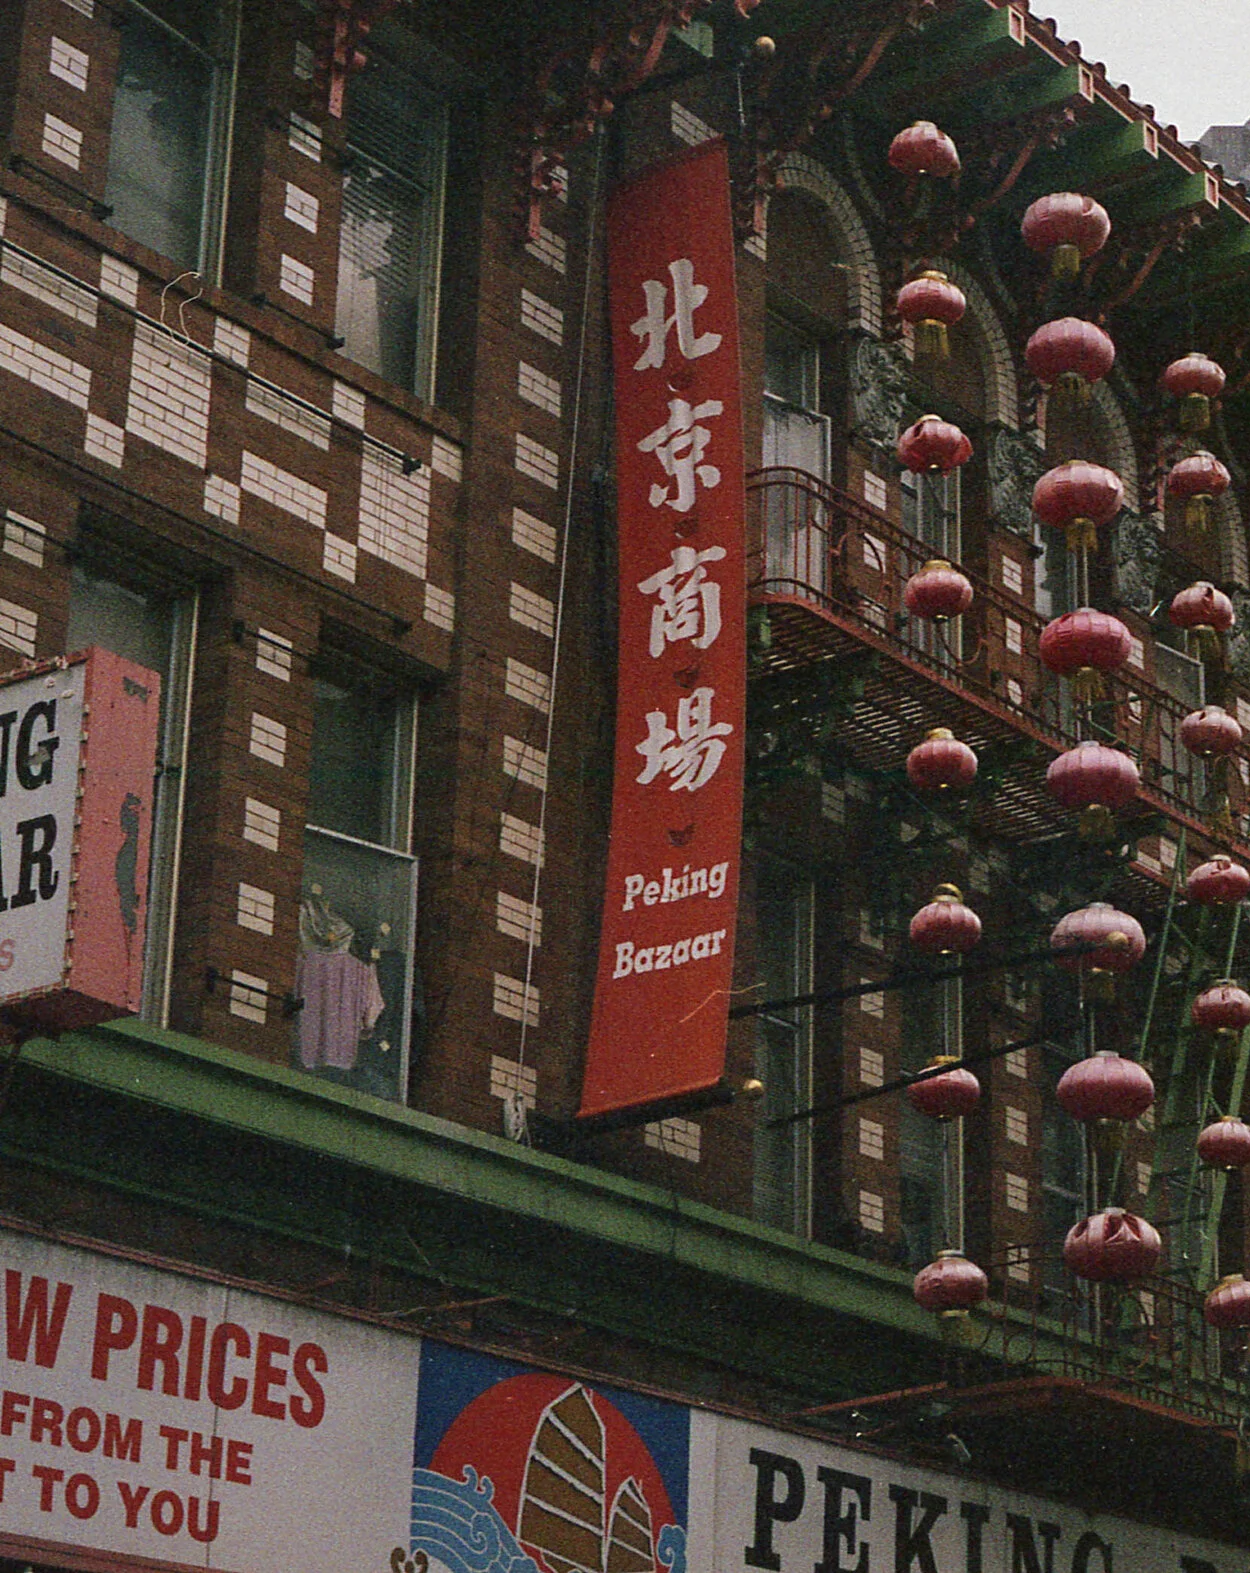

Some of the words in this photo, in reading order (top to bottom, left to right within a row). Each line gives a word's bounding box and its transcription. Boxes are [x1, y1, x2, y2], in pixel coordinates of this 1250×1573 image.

[631, 258, 732, 791] 北京商場
[0, 814, 59, 912] R
[622, 861, 729, 912] Peking
[613, 928, 726, 980] Bazaar
[4, 1269, 73, 1369] W
[91, 1292, 329, 1429] PRICES
[1, 1390, 142, 1462] FROM
[158, 1425, 253, 1486] THE
[32, 1464, 100, 1520] TO
[116, 1481, 221, 1544] YOU
